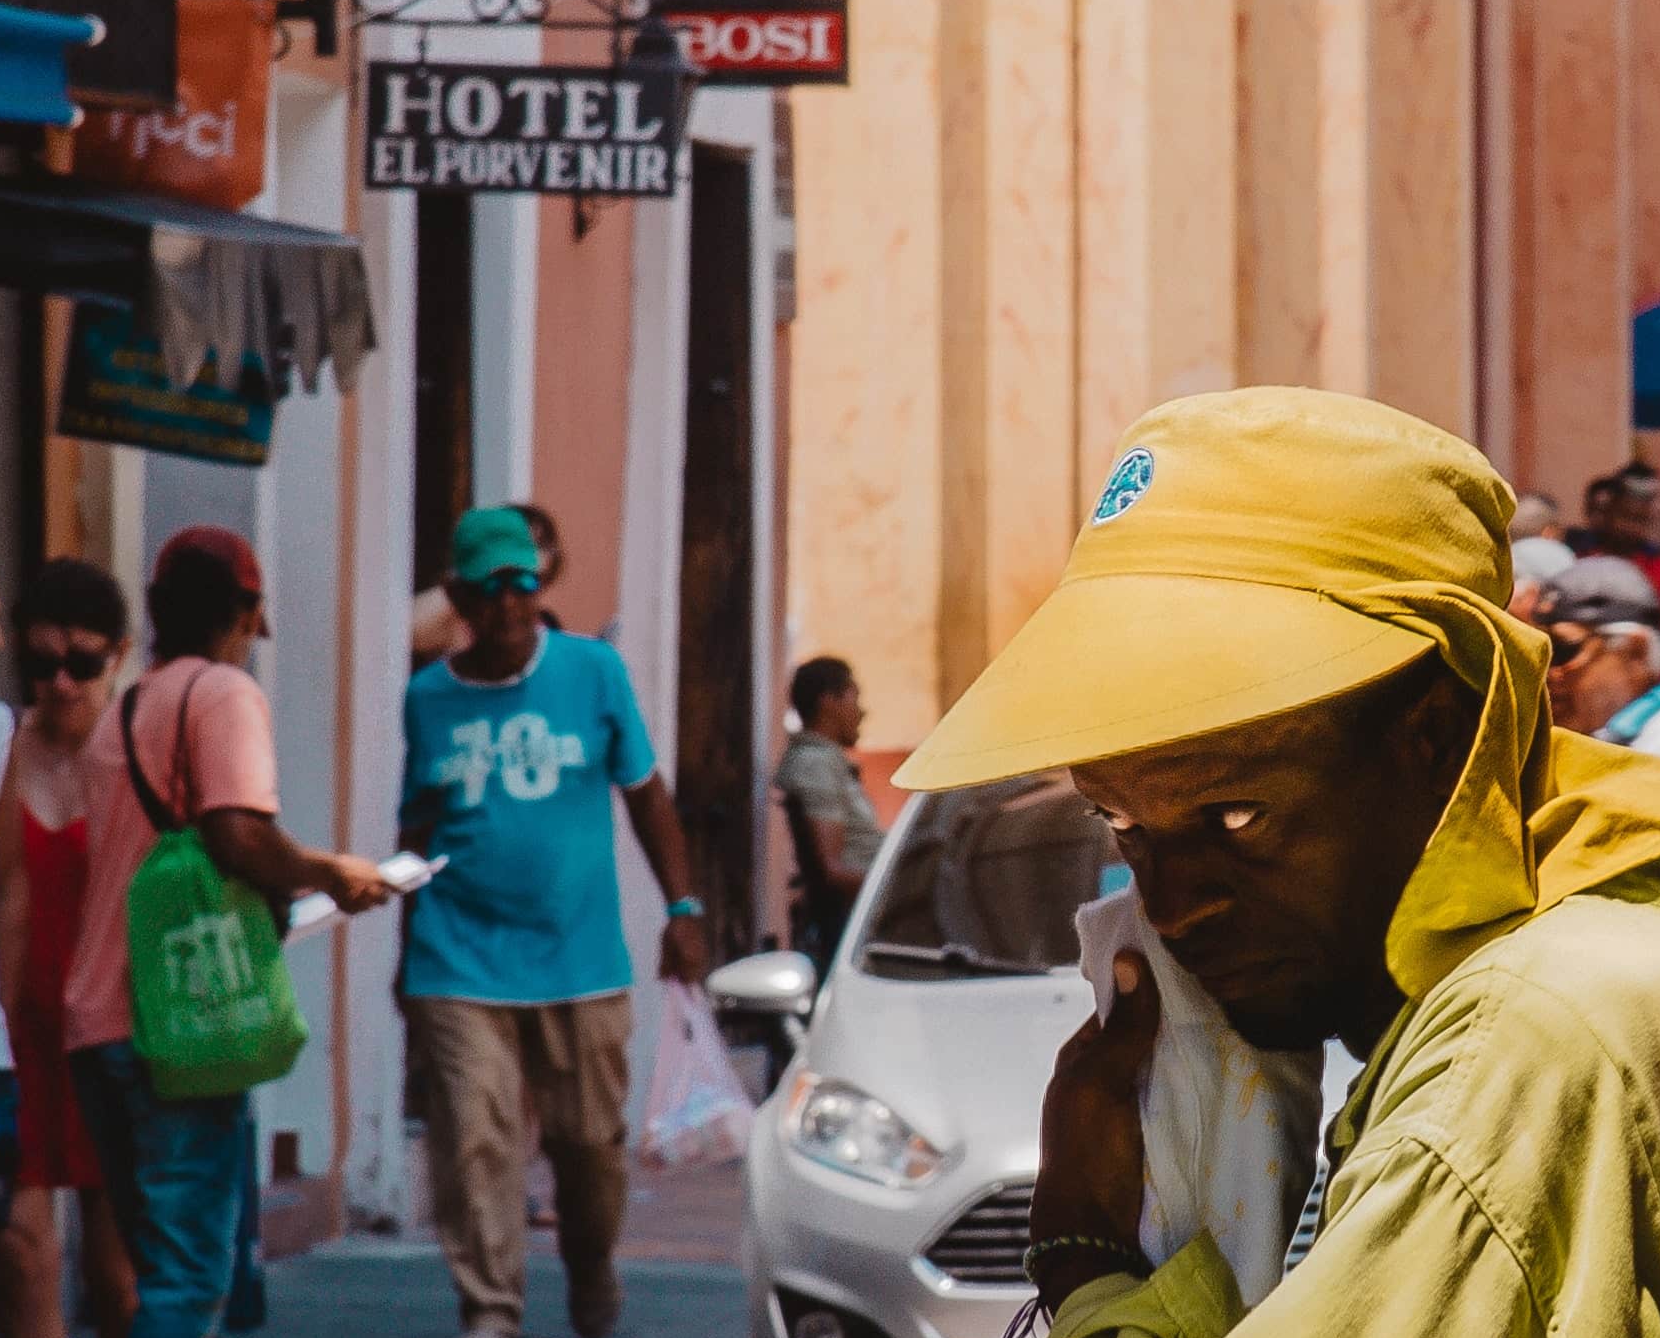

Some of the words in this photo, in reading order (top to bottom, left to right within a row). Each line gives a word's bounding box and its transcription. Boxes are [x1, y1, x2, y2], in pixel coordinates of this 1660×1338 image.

[676, 16, 830, 63] BOSI
[384, 73, 663, 142] HOTEL
[372, 136, 431, 184] EL
[432, 139, 670, 191] PORVENIR
